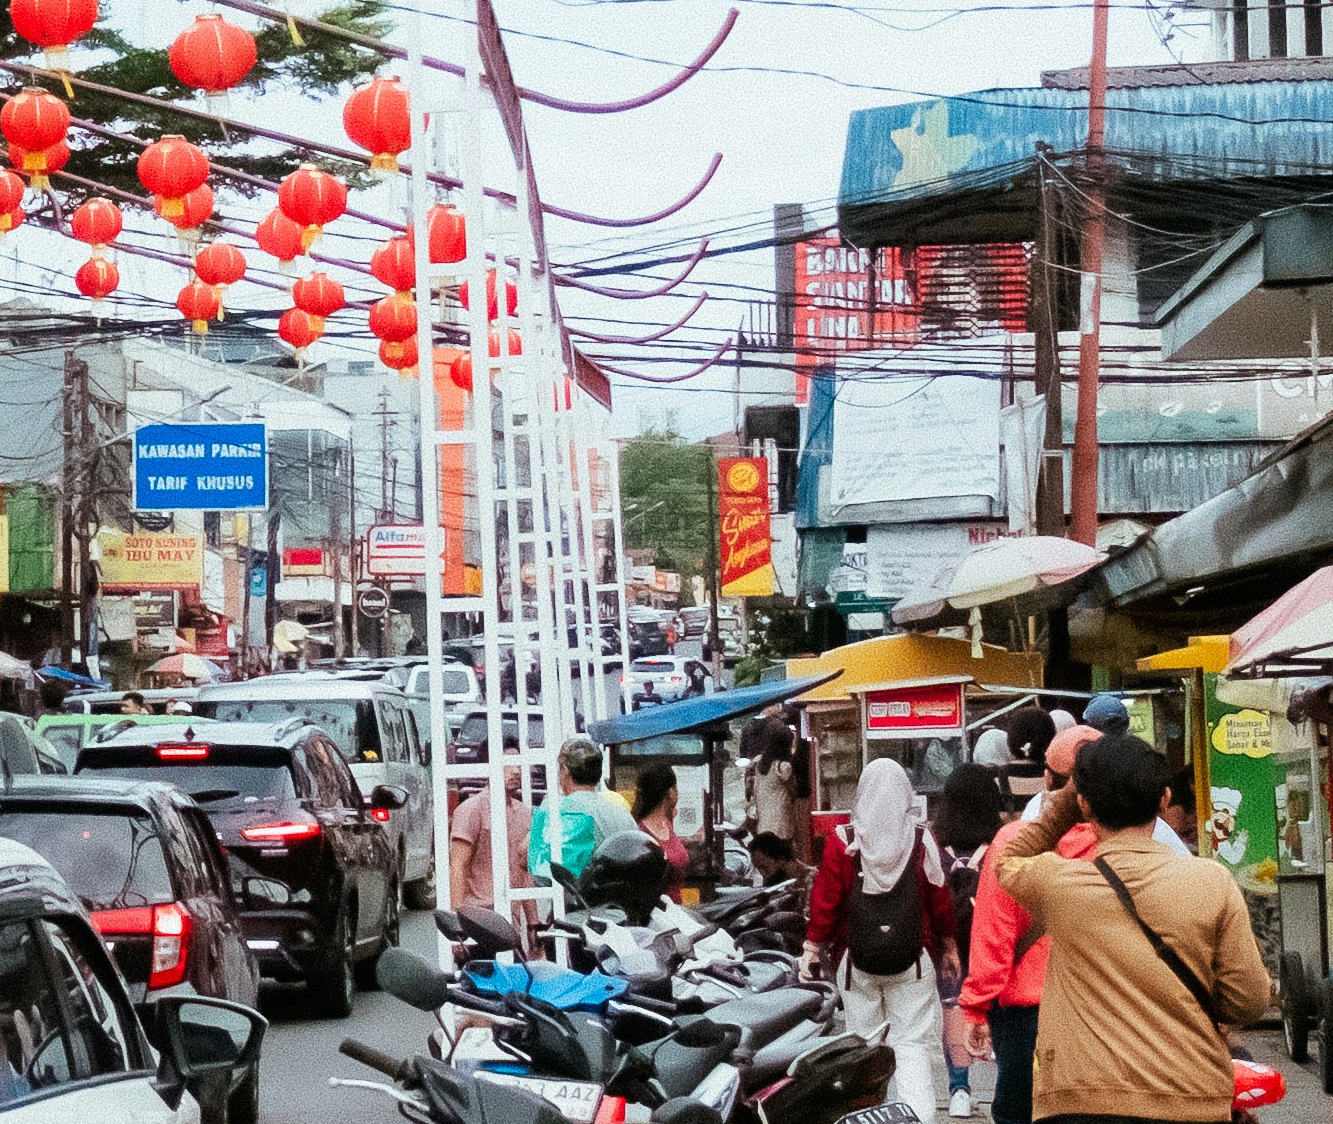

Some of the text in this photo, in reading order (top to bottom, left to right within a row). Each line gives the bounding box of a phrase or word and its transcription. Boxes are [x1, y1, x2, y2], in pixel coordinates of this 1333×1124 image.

[139, 444, 205, 458] KAWASAN
[147, 475, 254, 491] TARIF KHUSUS
[125, 538, 153, 548] SOTO
[126, 550, 195, 562] IBU MAY
